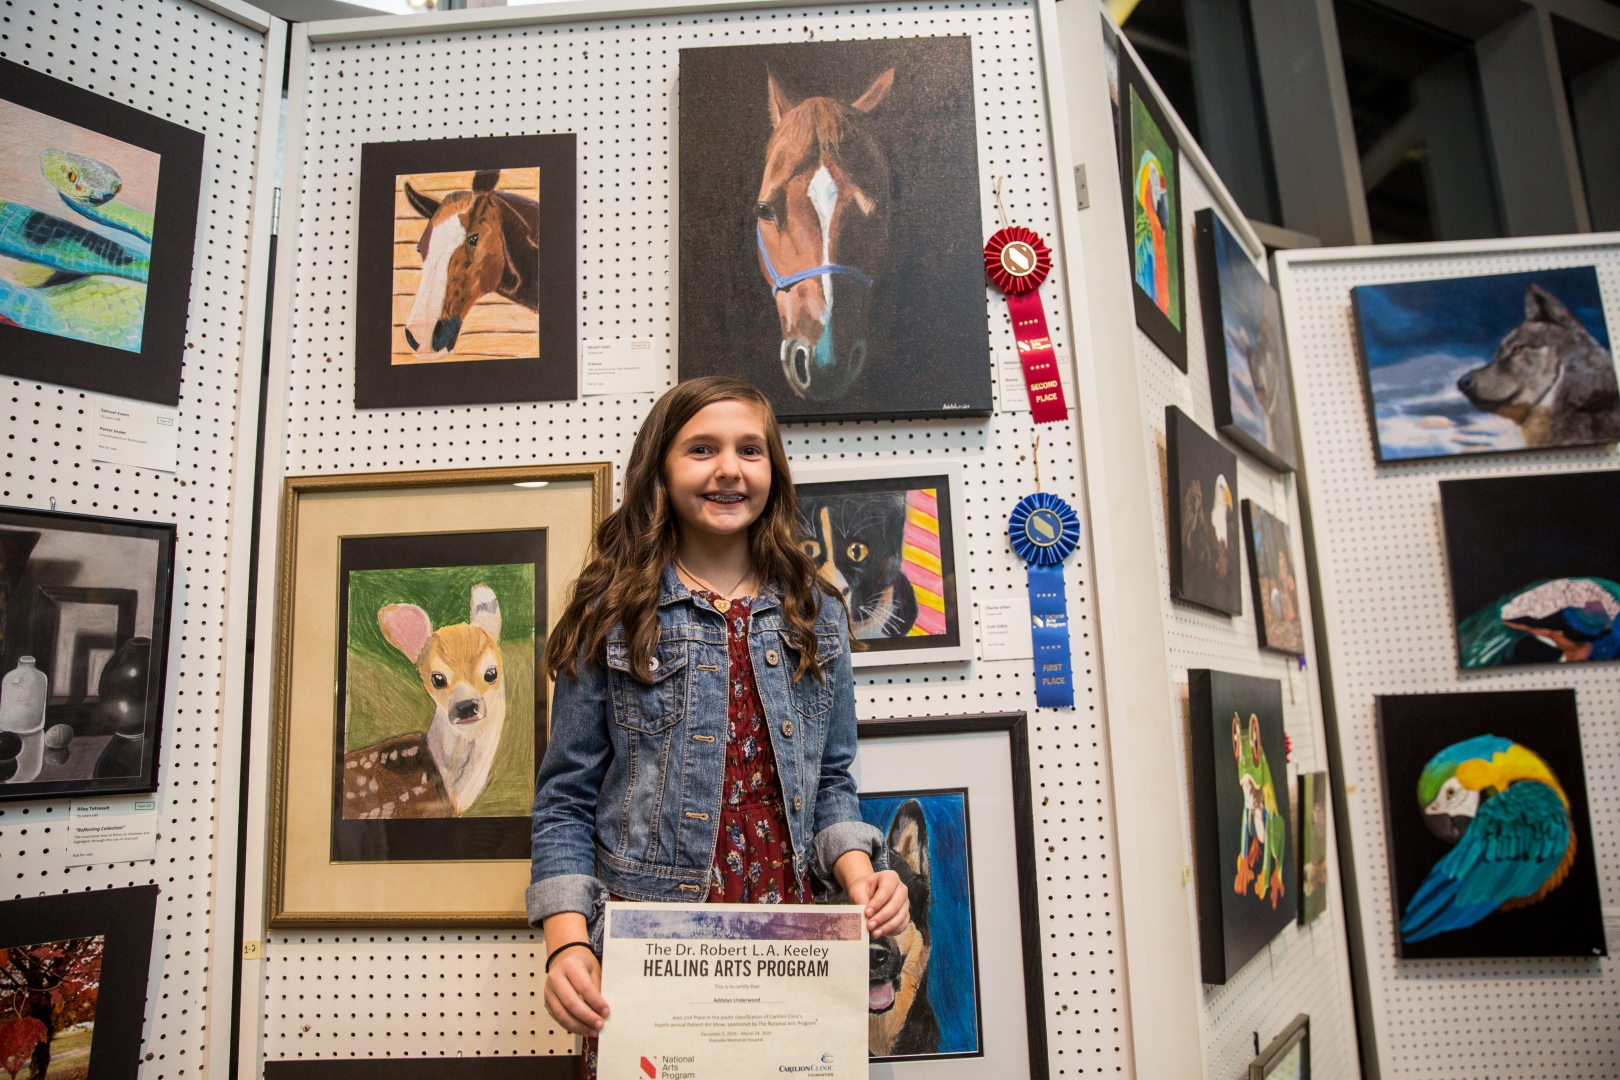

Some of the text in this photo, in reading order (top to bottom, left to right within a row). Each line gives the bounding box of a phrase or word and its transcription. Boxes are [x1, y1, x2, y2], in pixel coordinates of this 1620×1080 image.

[1030, 380, 1058, 391] SECOND
[1036, 393, 1058, 403] PLACE
[646, 943, 671, 956] The
[676, 944, 695, 956] Dr.
[700, 944, 747, 956] Robert
[784, 945, 829, 959] Keeley
[644, 960, 829, 977] HEALING ARTS PROGRAM
[662, 1072, 695, 1080] Program
